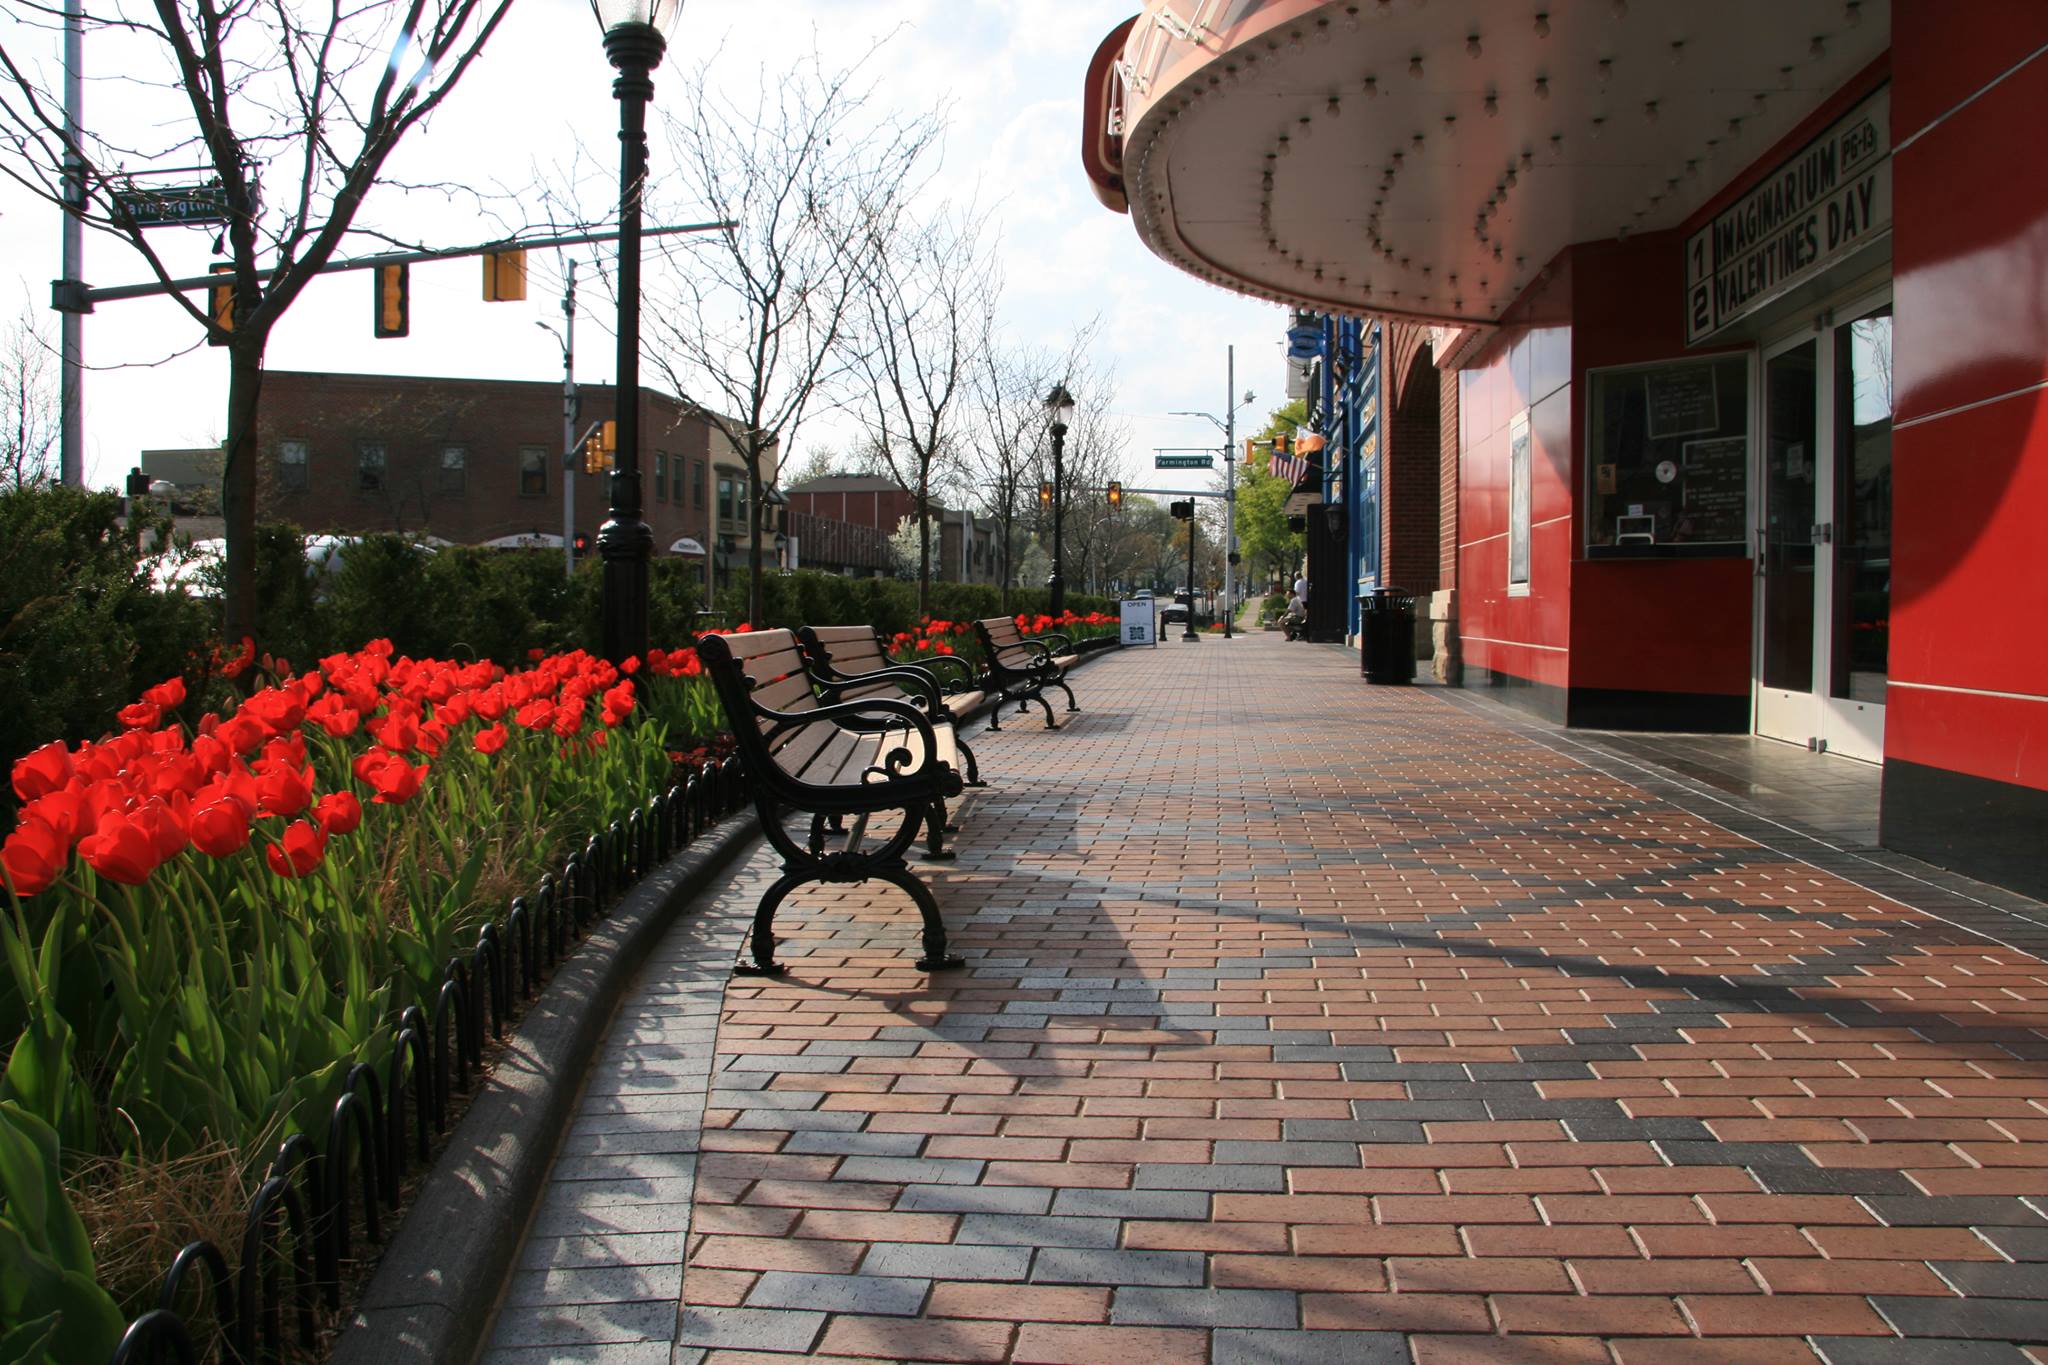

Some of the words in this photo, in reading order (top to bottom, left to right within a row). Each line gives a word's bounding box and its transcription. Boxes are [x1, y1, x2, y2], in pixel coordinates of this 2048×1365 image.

[1693, 285, 1710, 331] 2
[1718, 212, 1818, 316] VALENTINES
[1827, 174, 1875, 252] DAY
[1694, 238, 1704, 279] 1
[1716, 138, 1836, 265] IMAGINARIUM
[1842, 121, 1875, 168] PG-13
[1157, 459, 1199, 467] Farmington
